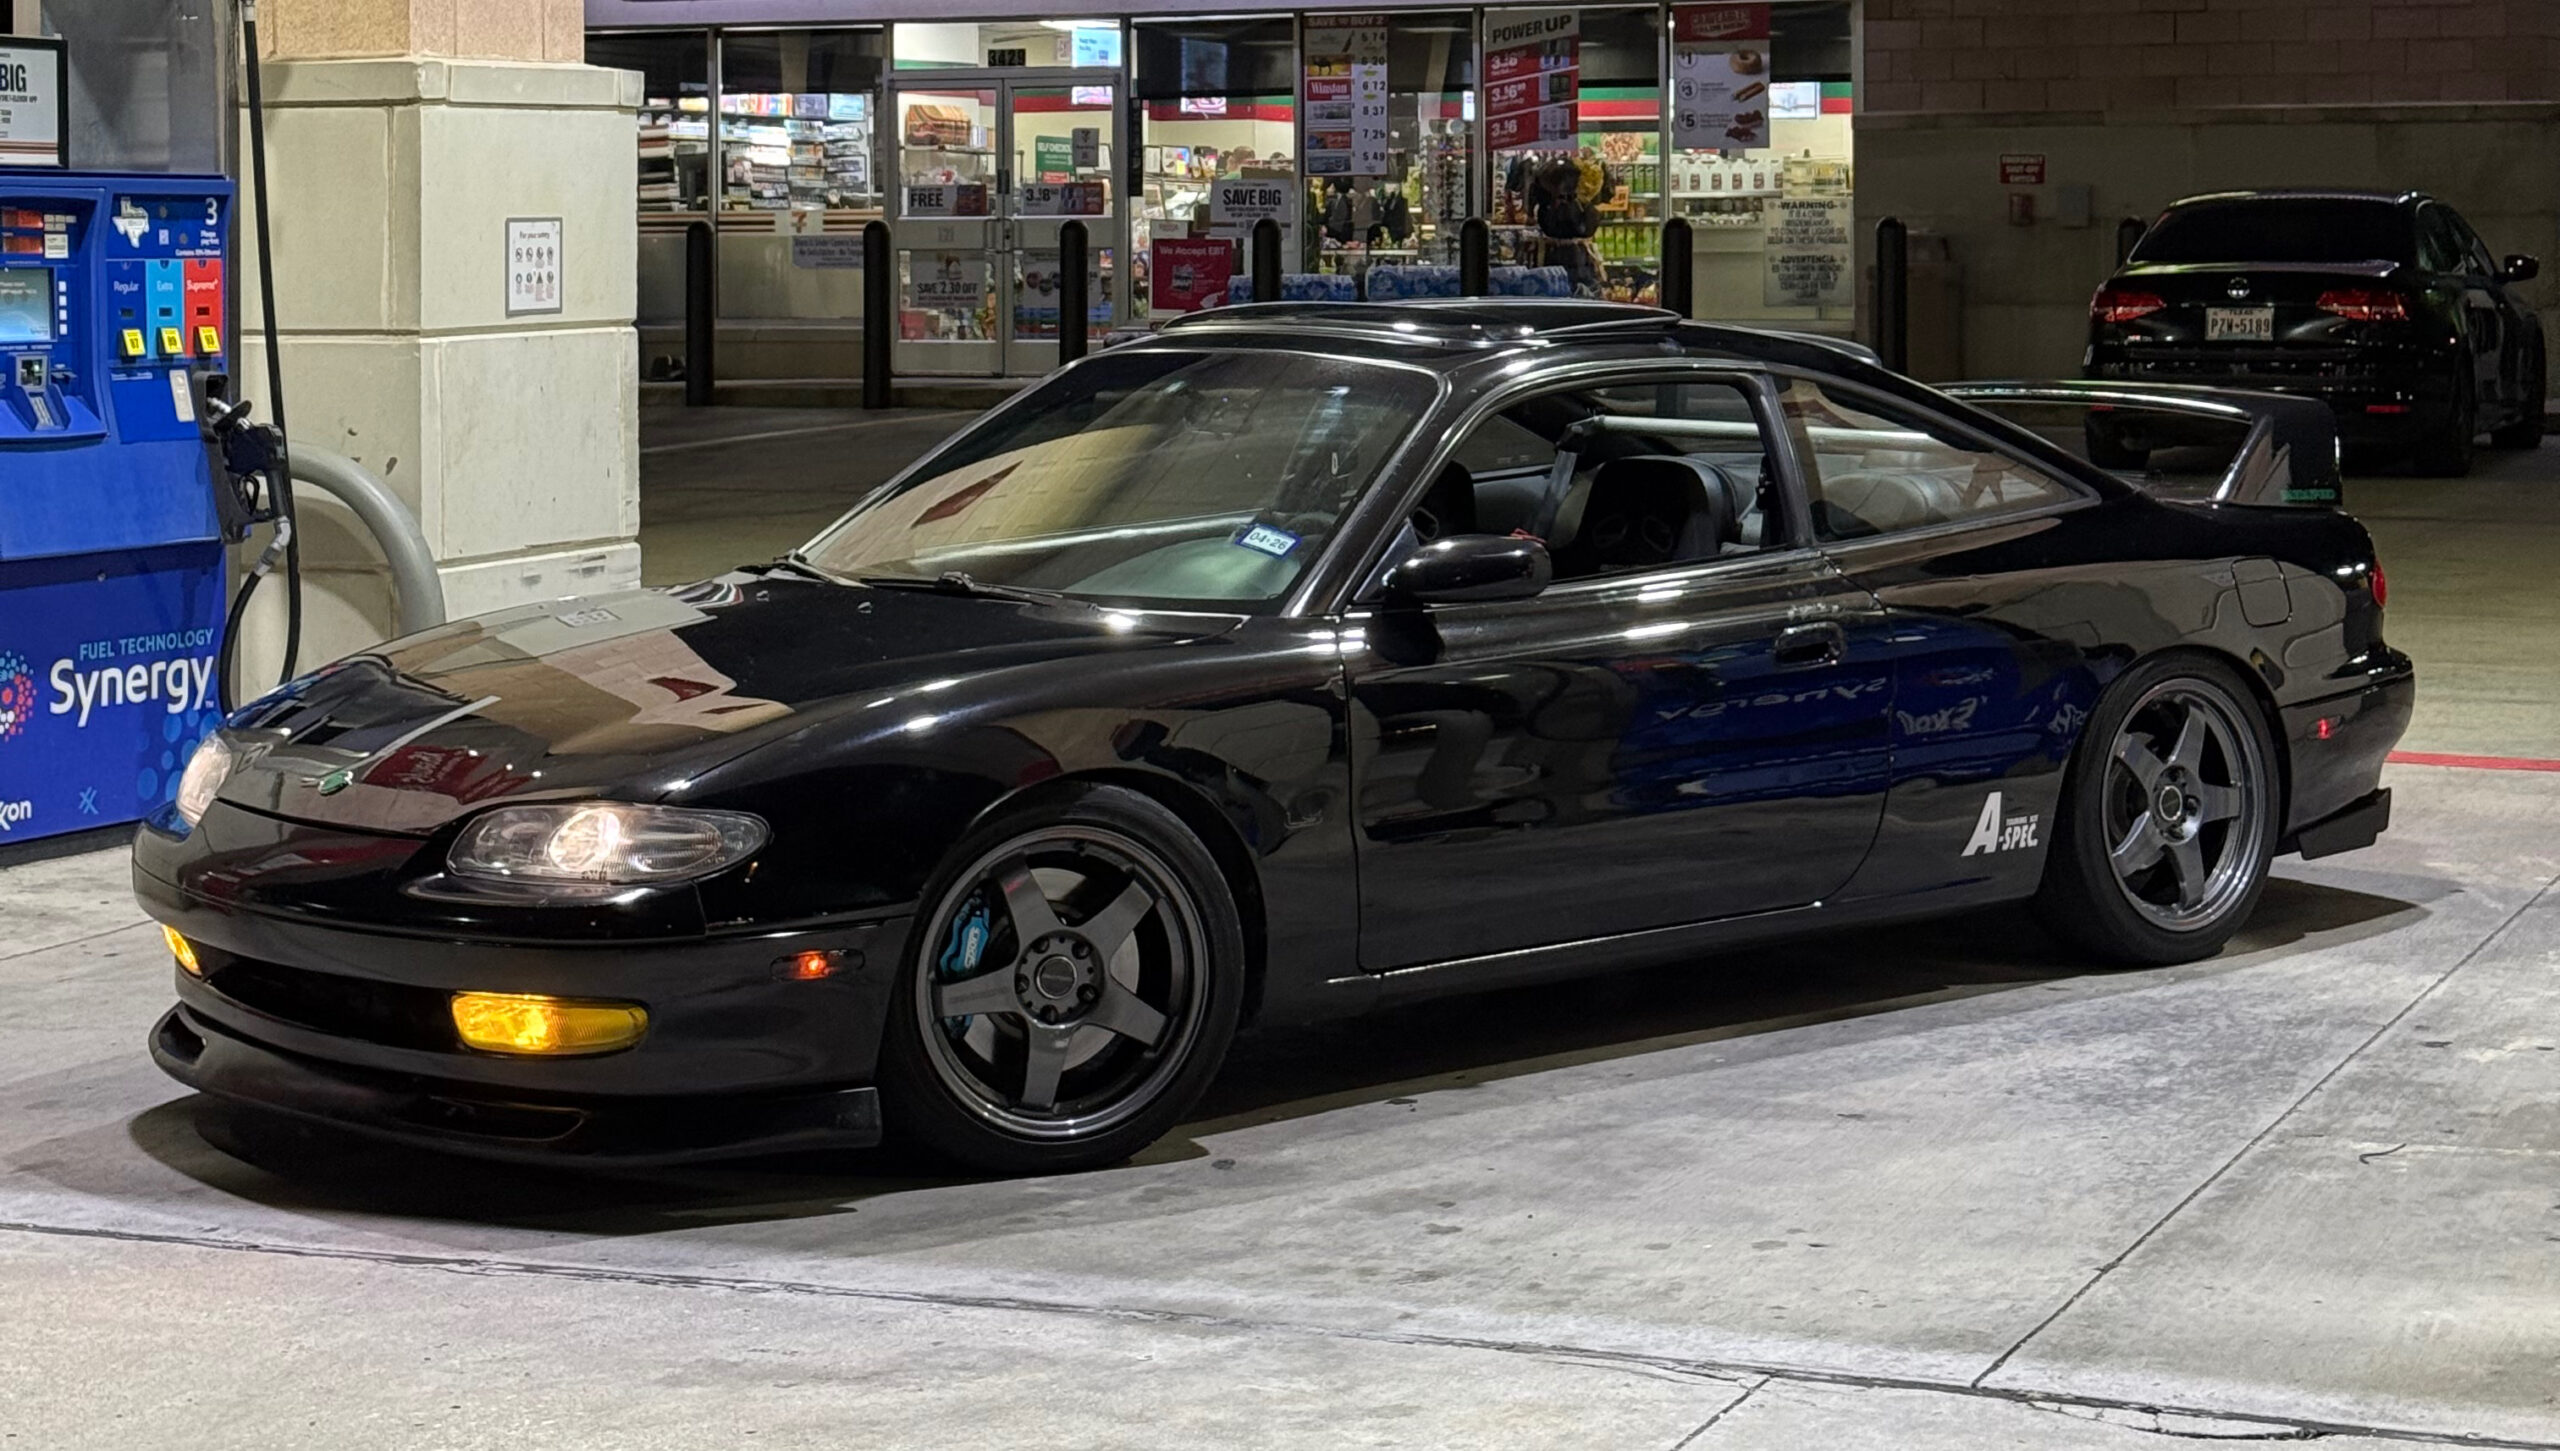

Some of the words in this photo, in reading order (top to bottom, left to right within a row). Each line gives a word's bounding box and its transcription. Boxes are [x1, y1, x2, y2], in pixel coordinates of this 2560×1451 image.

[1351, 15, 1373, 26] BUY
[1492, 21, 1542, 43] POWER
[1545, 15, 1572, 32] UP
[0, 63, 27, 92] BIG
[1311, 82, 1348, 94] Winston
[910, 193, 944, 207] FREE
[1222, 189, 1256, 206] SAVE
[1259, 189, 1282, 206] BIG
[205, 198, 218, 226] 3
[1160, 247, 1173, 255] We
[1175, 247, 1206, 257] Accept
[1208, 246, 1226, 256] EBT
[113, 281, 140, 295] Regular
[157, 281, 174, 292] Extra
[963, 282, 978, 294] OFF
[80, 641, 115, 661] FUEL
[119, 628, 214, 655] TECHNOLOGY
[50, 656, 214, 728] Synergy
[1960, 791, 2040, 857] A-SPEC
